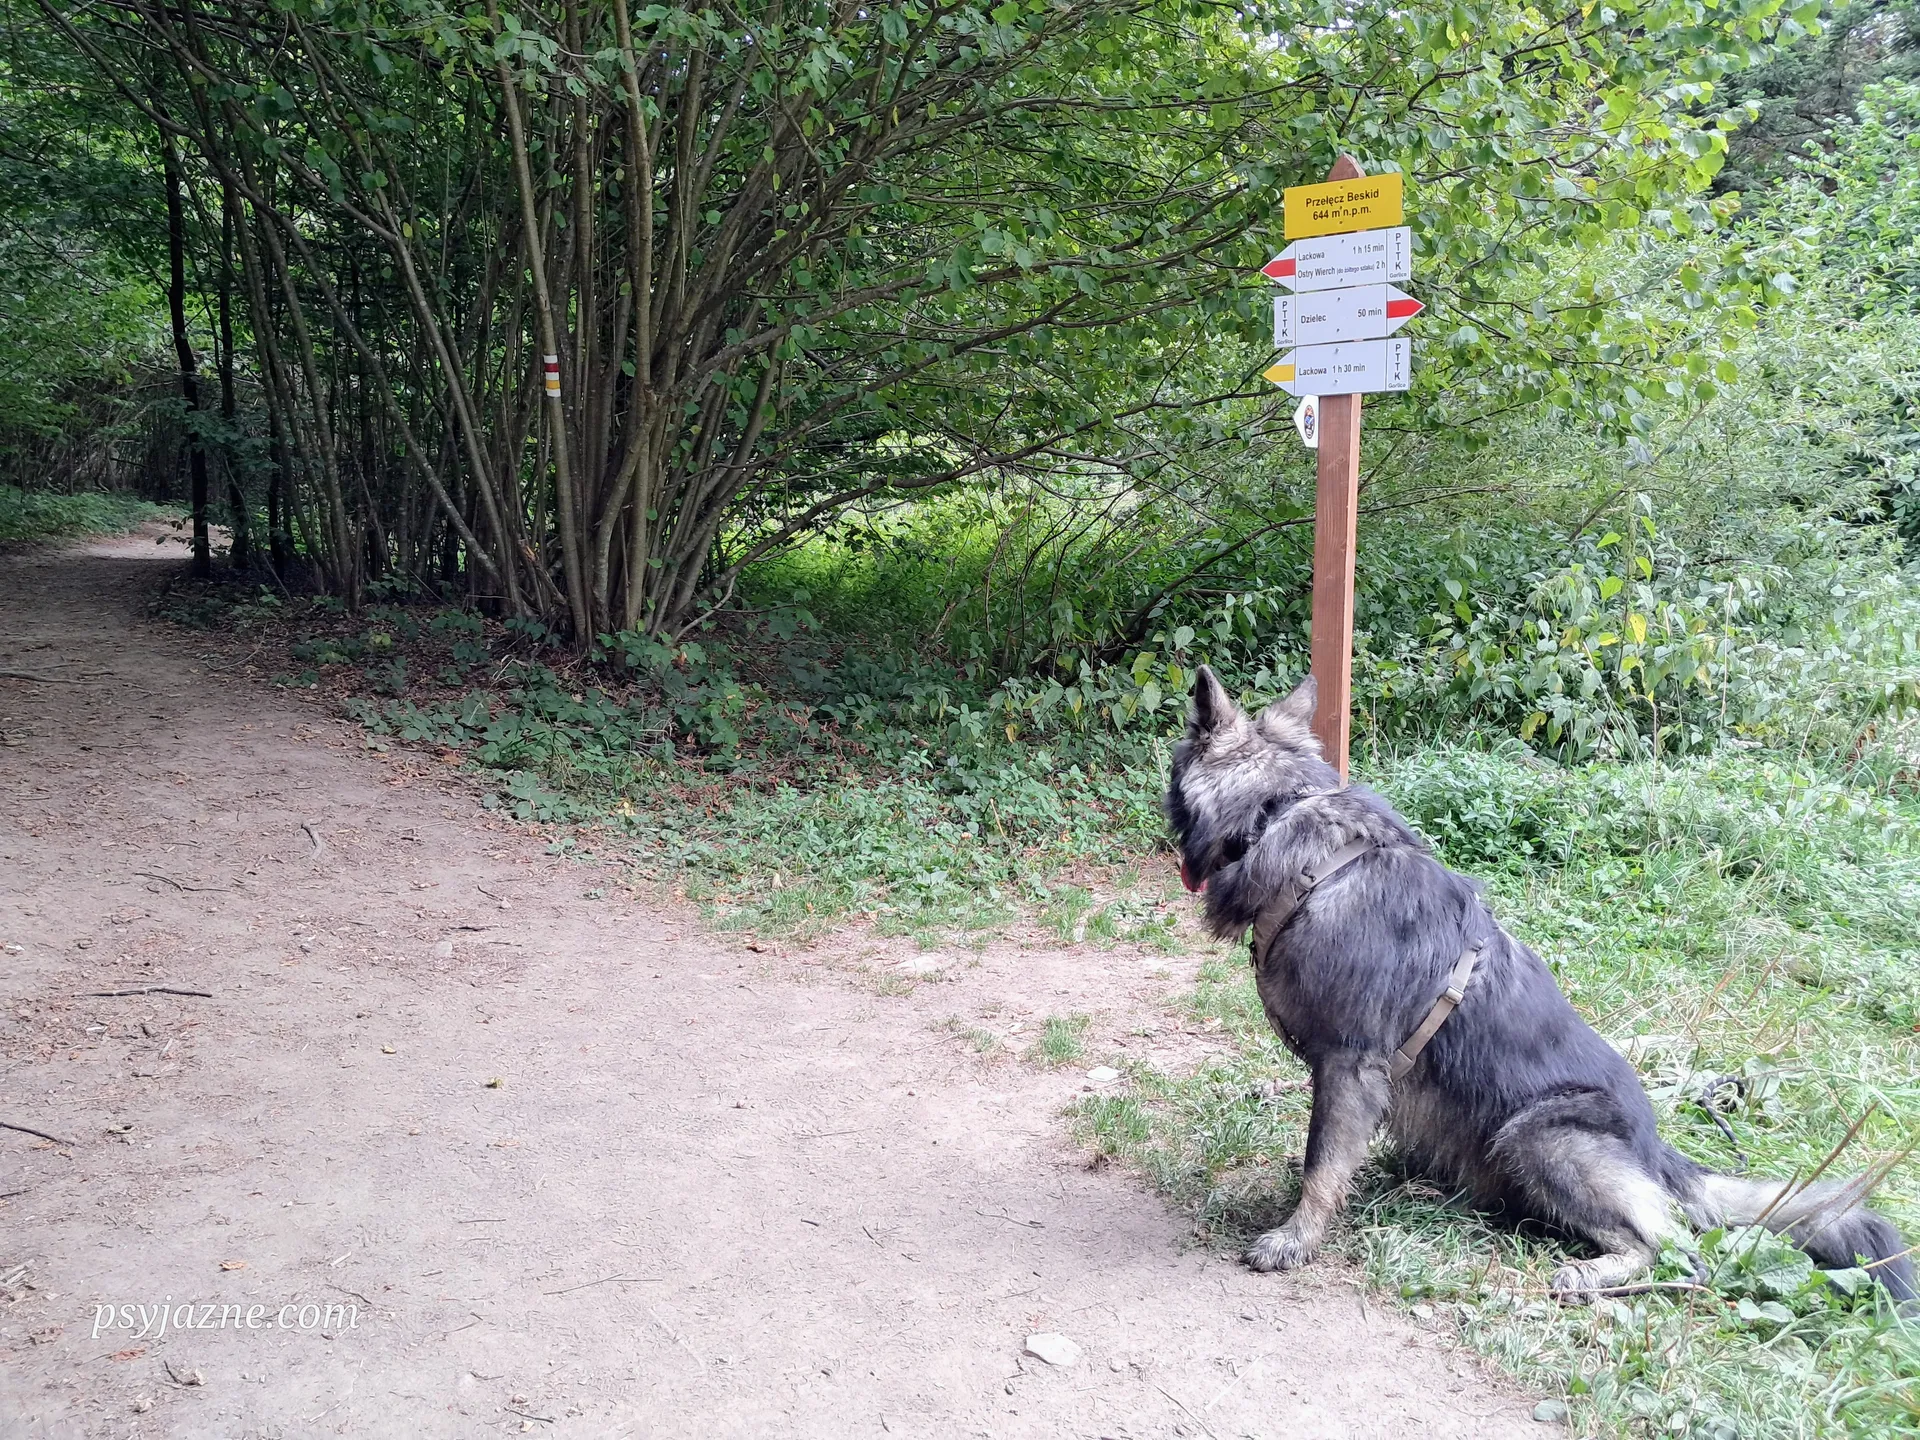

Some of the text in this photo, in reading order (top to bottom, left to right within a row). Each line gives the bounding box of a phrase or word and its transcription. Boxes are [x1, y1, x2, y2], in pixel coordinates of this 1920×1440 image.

[1306, 189, 1379, 208] Przełęcz Beskid
[1313, 205, 1371, 221] 644 m n.p.m.
[1298, 251, 1325, 261] Lackowa
[1358, 245, 1362, 254] h
[1364, 244, 1371, 253] 15
[1372, 244, 1384, 252] min
[1297, 269, 1314, 279] Ostry
[1315, 266, 1336, 276] Wierch
[1376, 260, 1380, 270] 2
[1381, 260, 1385, 269] h
[1301, 307, 1382, 324] Dzielec 50 min
[1299, 366, 1327, 376] Lackowa
[1338, 365, 1342, 373] h
[1344, 365, 1352, 373] 30
[1353, 363, 1365, 372] min
